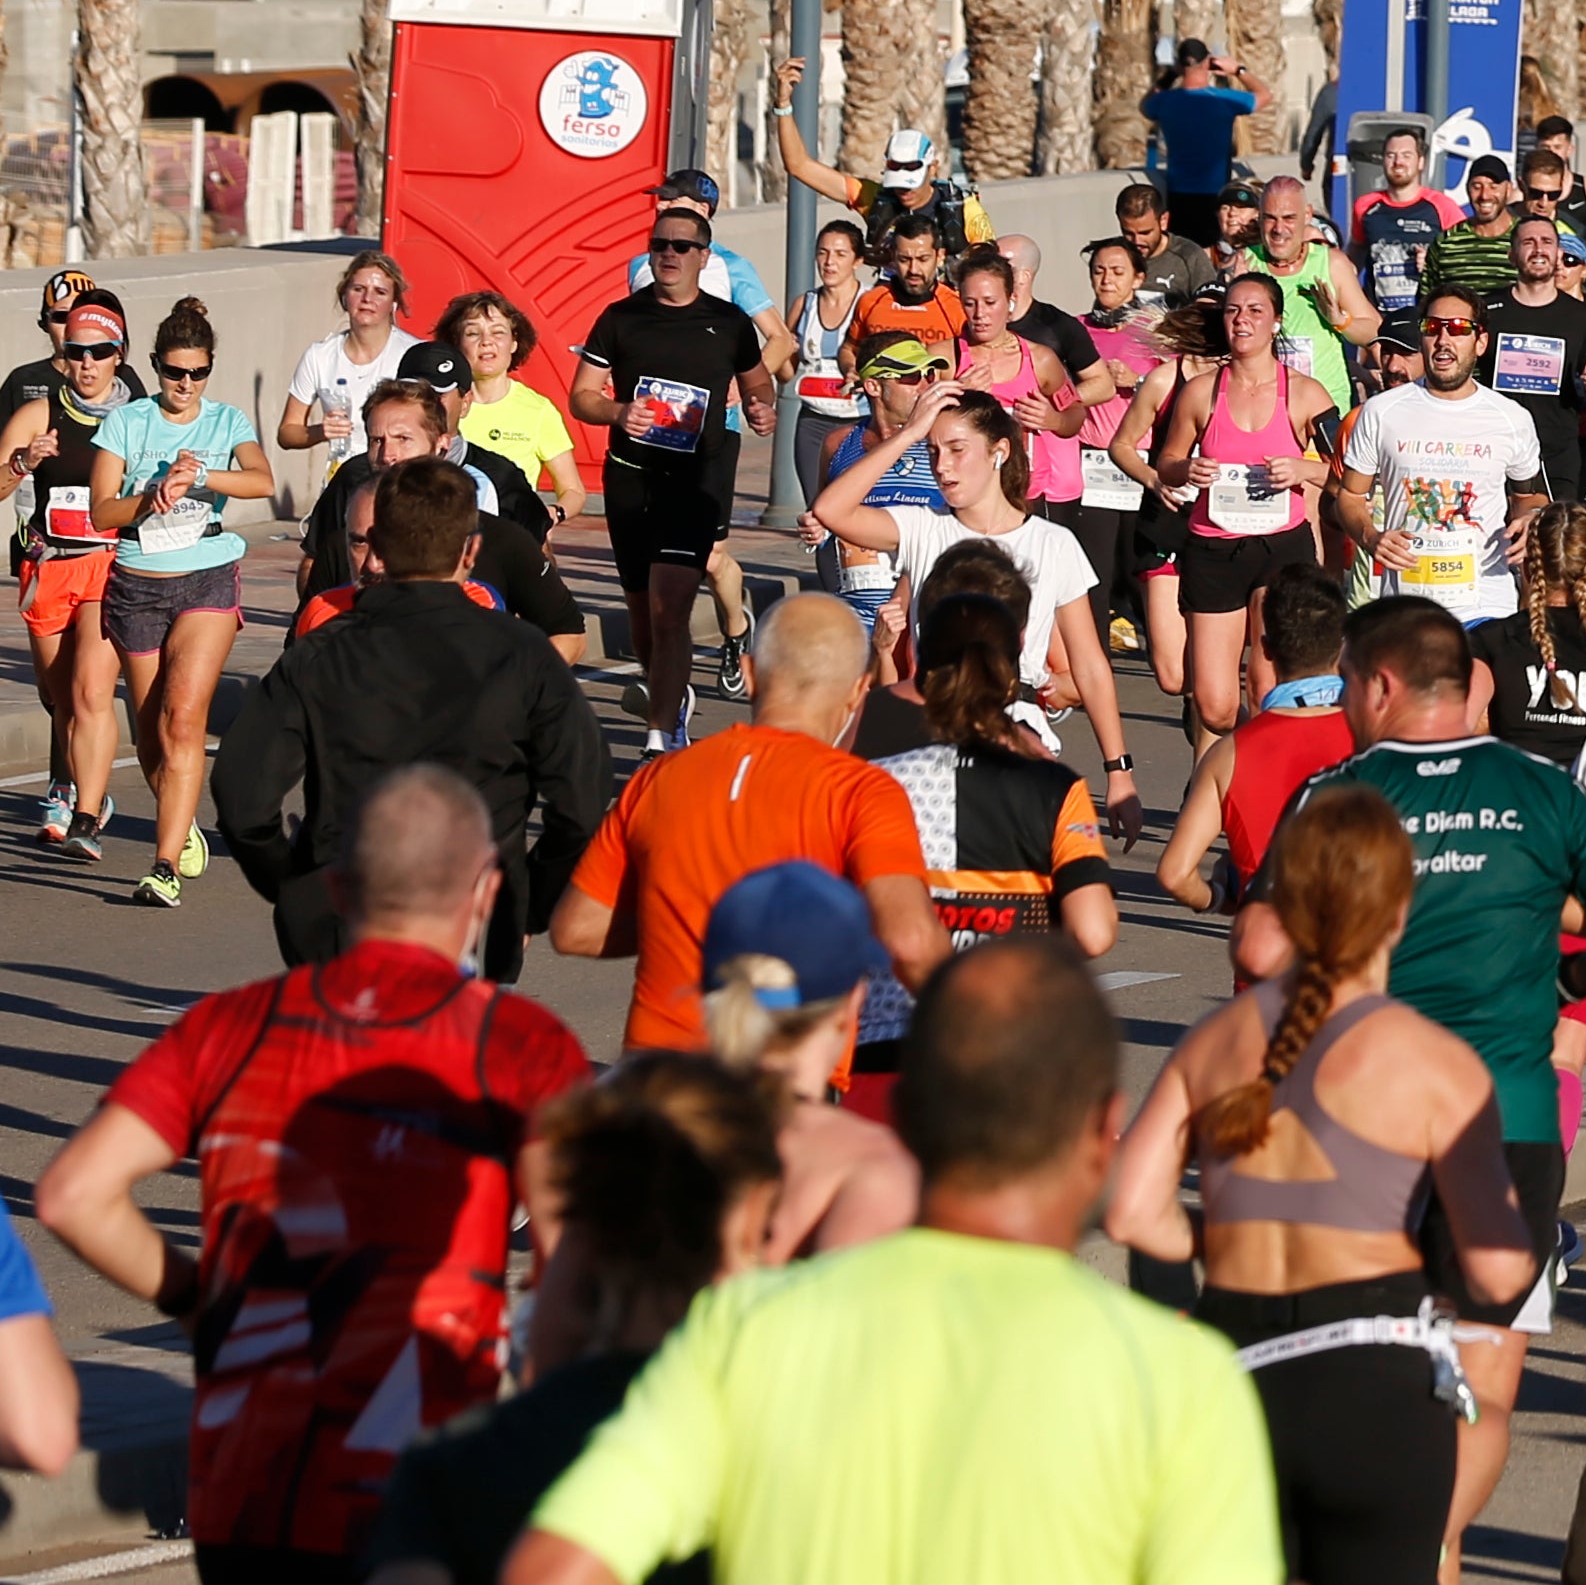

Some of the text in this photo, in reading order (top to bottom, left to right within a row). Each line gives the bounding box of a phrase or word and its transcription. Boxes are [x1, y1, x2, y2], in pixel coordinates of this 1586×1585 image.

[562, 115, 621, 138] fersa
[1525, 357, 1552, 369] 2592
[1424, 440, 1492, 460] CARRERA
[1418, 456, 1470, 469] SOLIDARIA
[172, 500, 205, 515] 8945
[1426, 538, 1461, 549] ZURICH
[1431, 561, 1464, 573] 5854
[1525, 710, 1558, 724] Personal
[1479, 807, 1524, 832] R.C.
[1413, 850, 1487, 876] raltar
[934, 904, 1017, 935] OTOS
